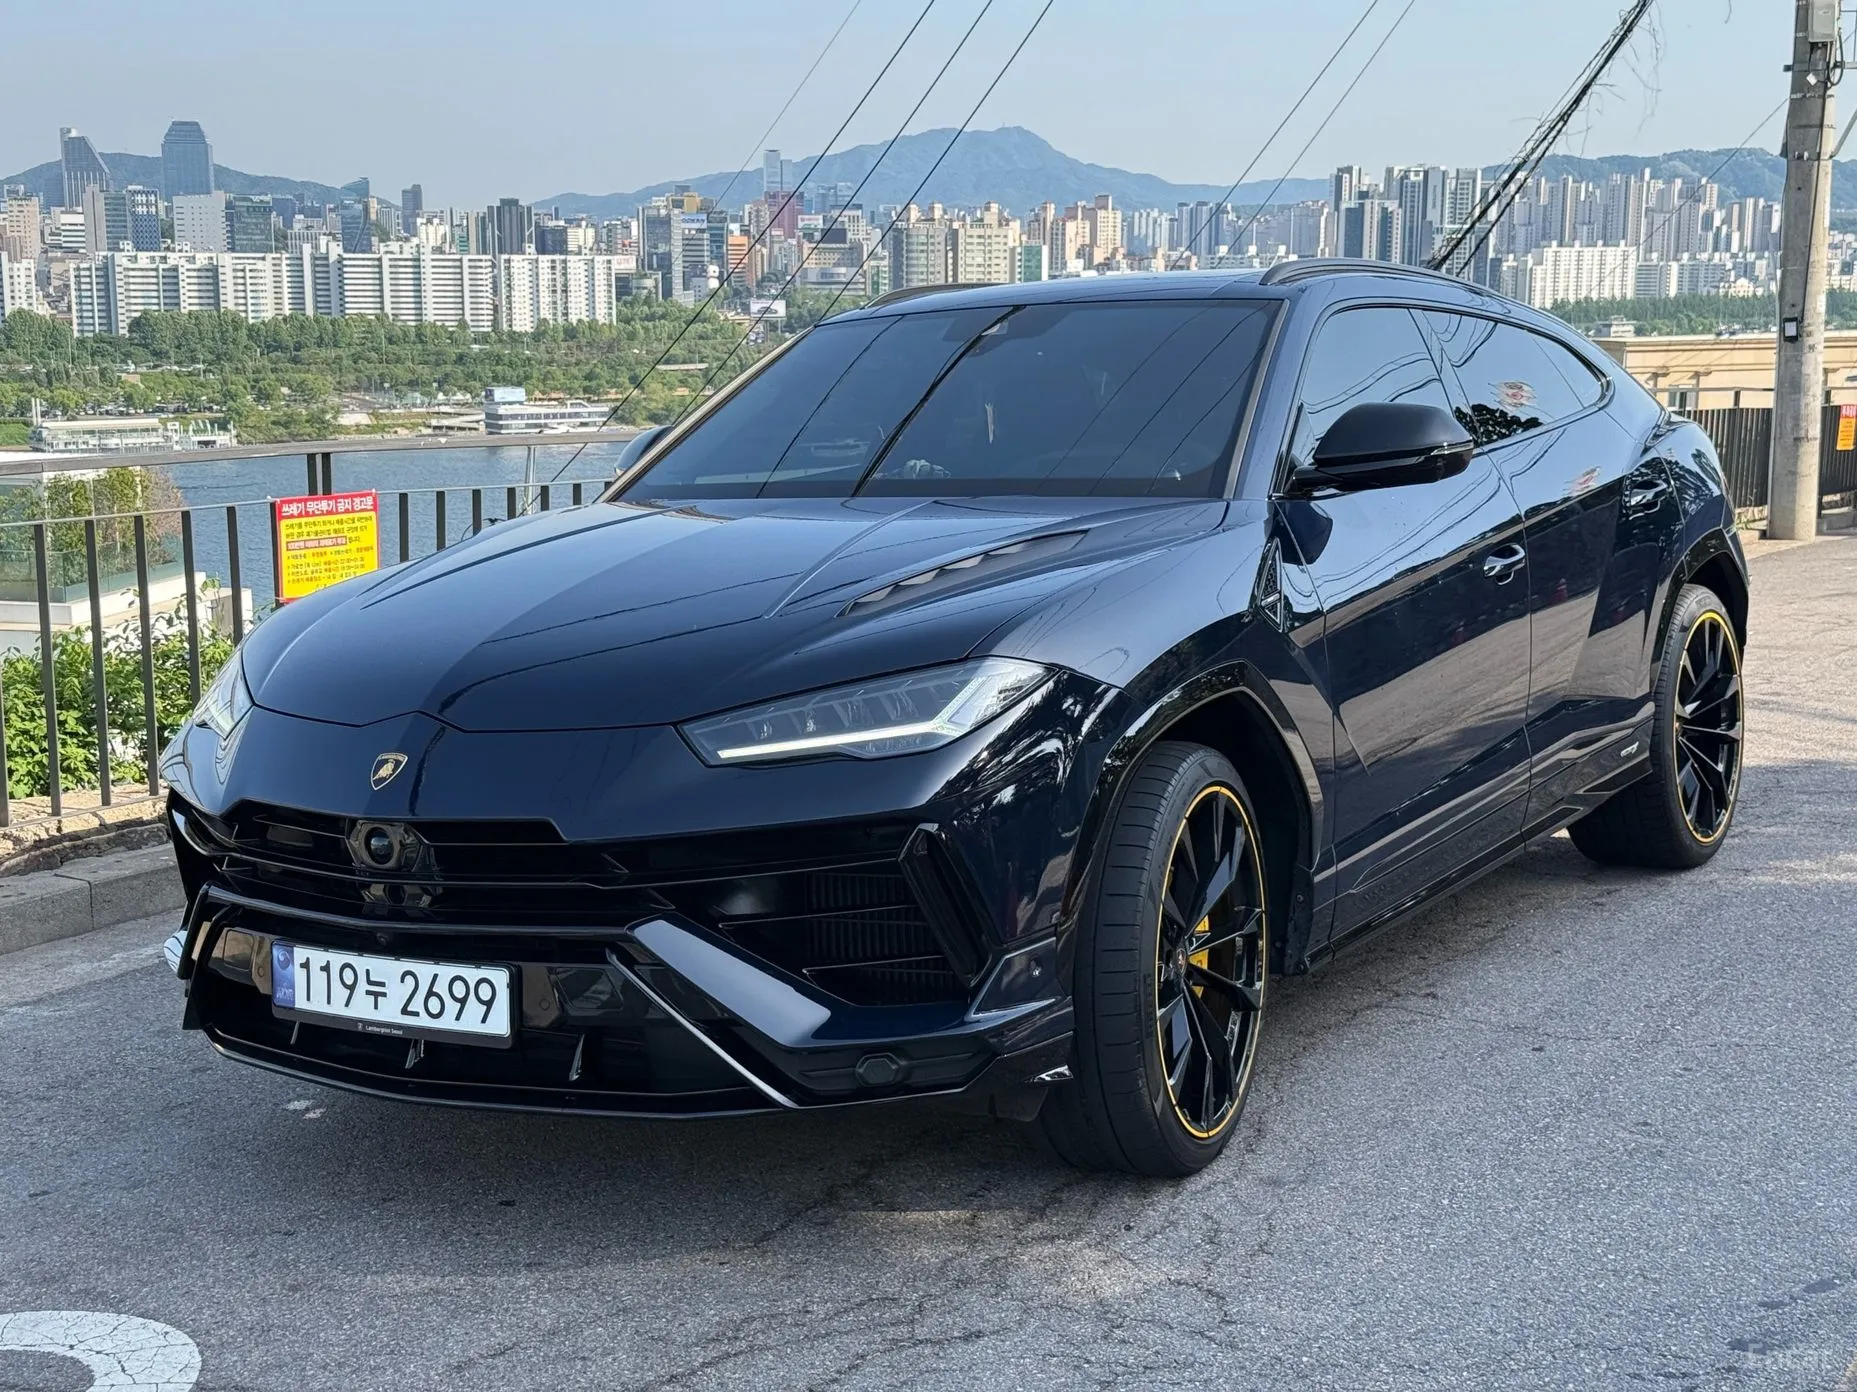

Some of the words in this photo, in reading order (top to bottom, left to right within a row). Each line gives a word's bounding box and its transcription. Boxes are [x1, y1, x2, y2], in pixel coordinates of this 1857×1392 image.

[282, 503, 304, 516] 쓰레기
[306, 500, 336, 514] 무단투기
[337, 498, 352, 512] 금지
[353, 496, 374, 510] 경고문
[299, 956, 388, 1010] 119누
[399, 969, 497, 1024] 2699
